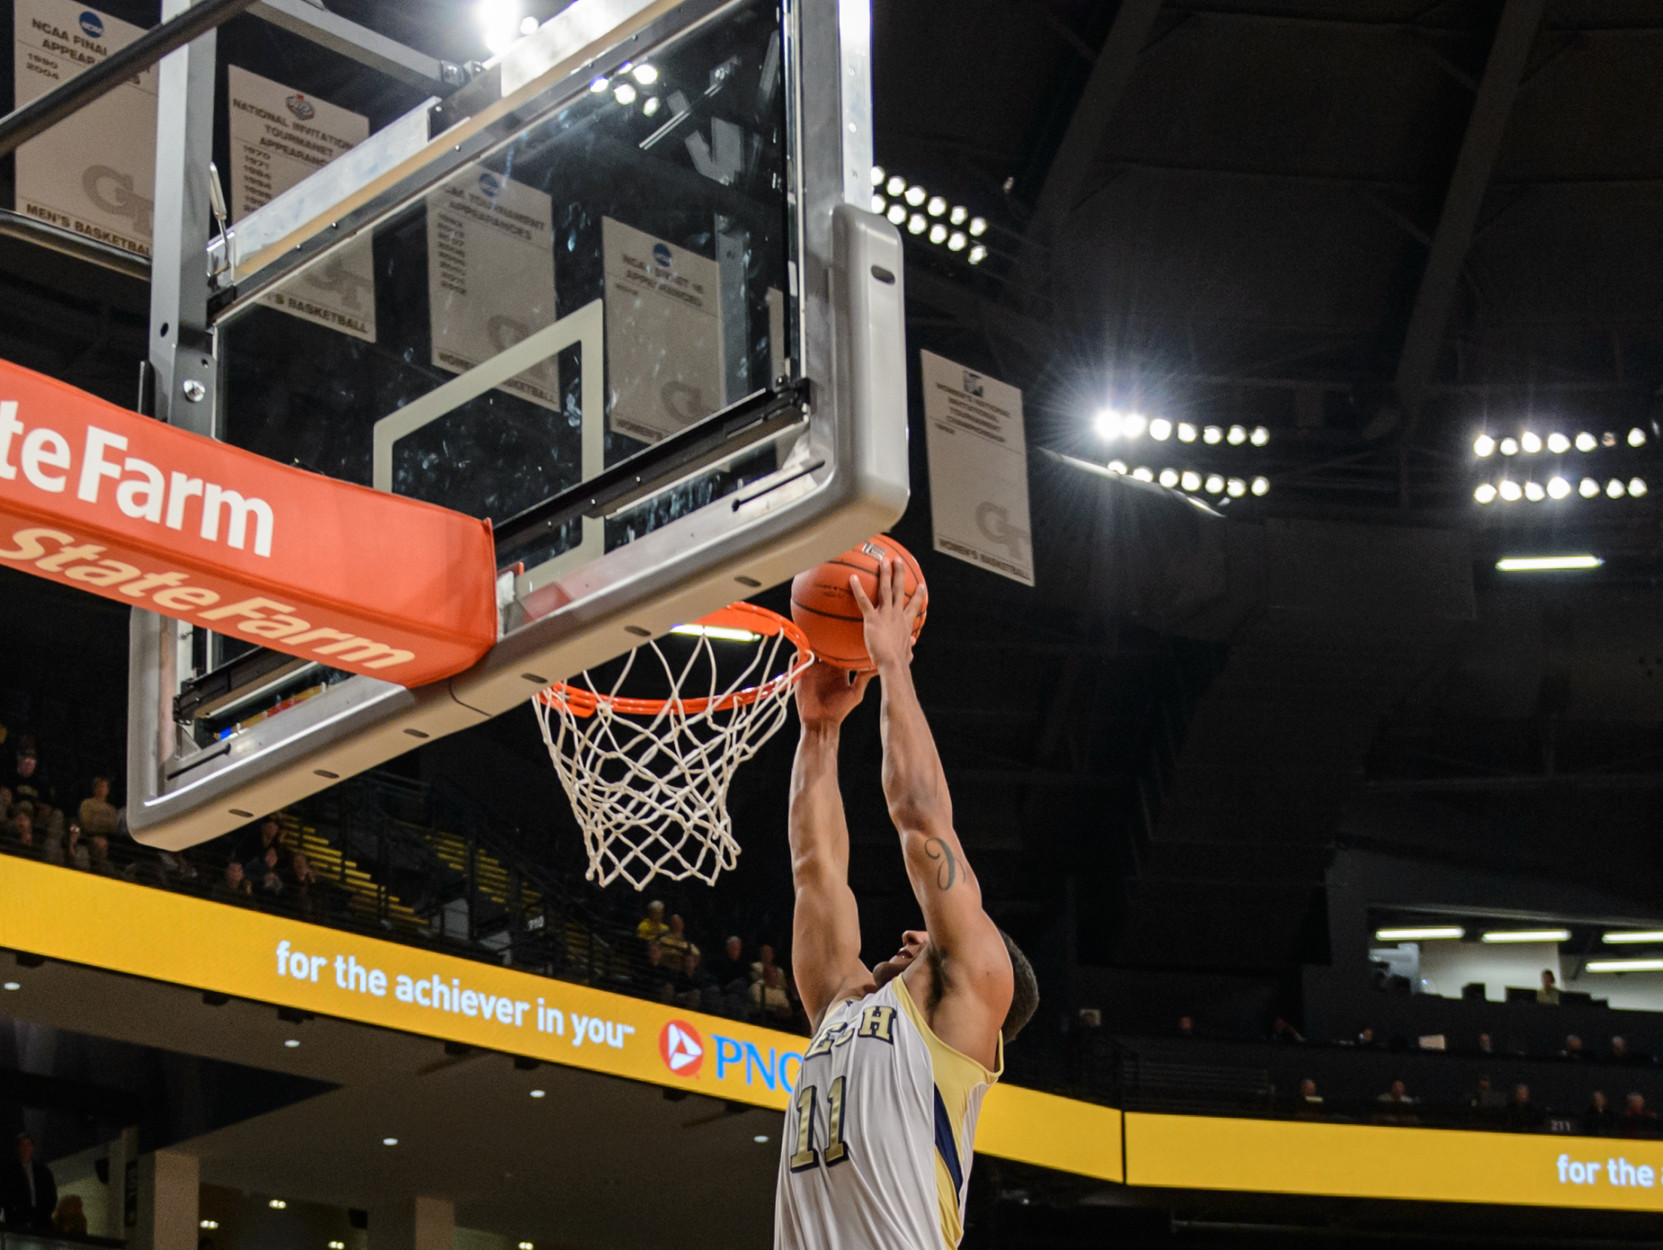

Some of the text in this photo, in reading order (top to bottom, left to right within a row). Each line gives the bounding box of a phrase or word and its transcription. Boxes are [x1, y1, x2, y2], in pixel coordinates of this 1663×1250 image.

[32, 19, 69, 41] NCAA
[26, 62, 59, 80] 2004
[233, 98, 289, 127] NATIONAL
[27, 204, 150, 257] MEN'S BASKETBAL
[288, 297, 368, 333] BASKETBALL
[276, 939, 328, 981] for
[335, 954, 388, 997] the
[394, 972, 531, 1026] achiever
[537, 998, 564, 1036] in
[790, 1075, 849, 1173] 11
[1556, 1154, 1601, 1184] for
[1607, 1158, 1654, 1188] the
